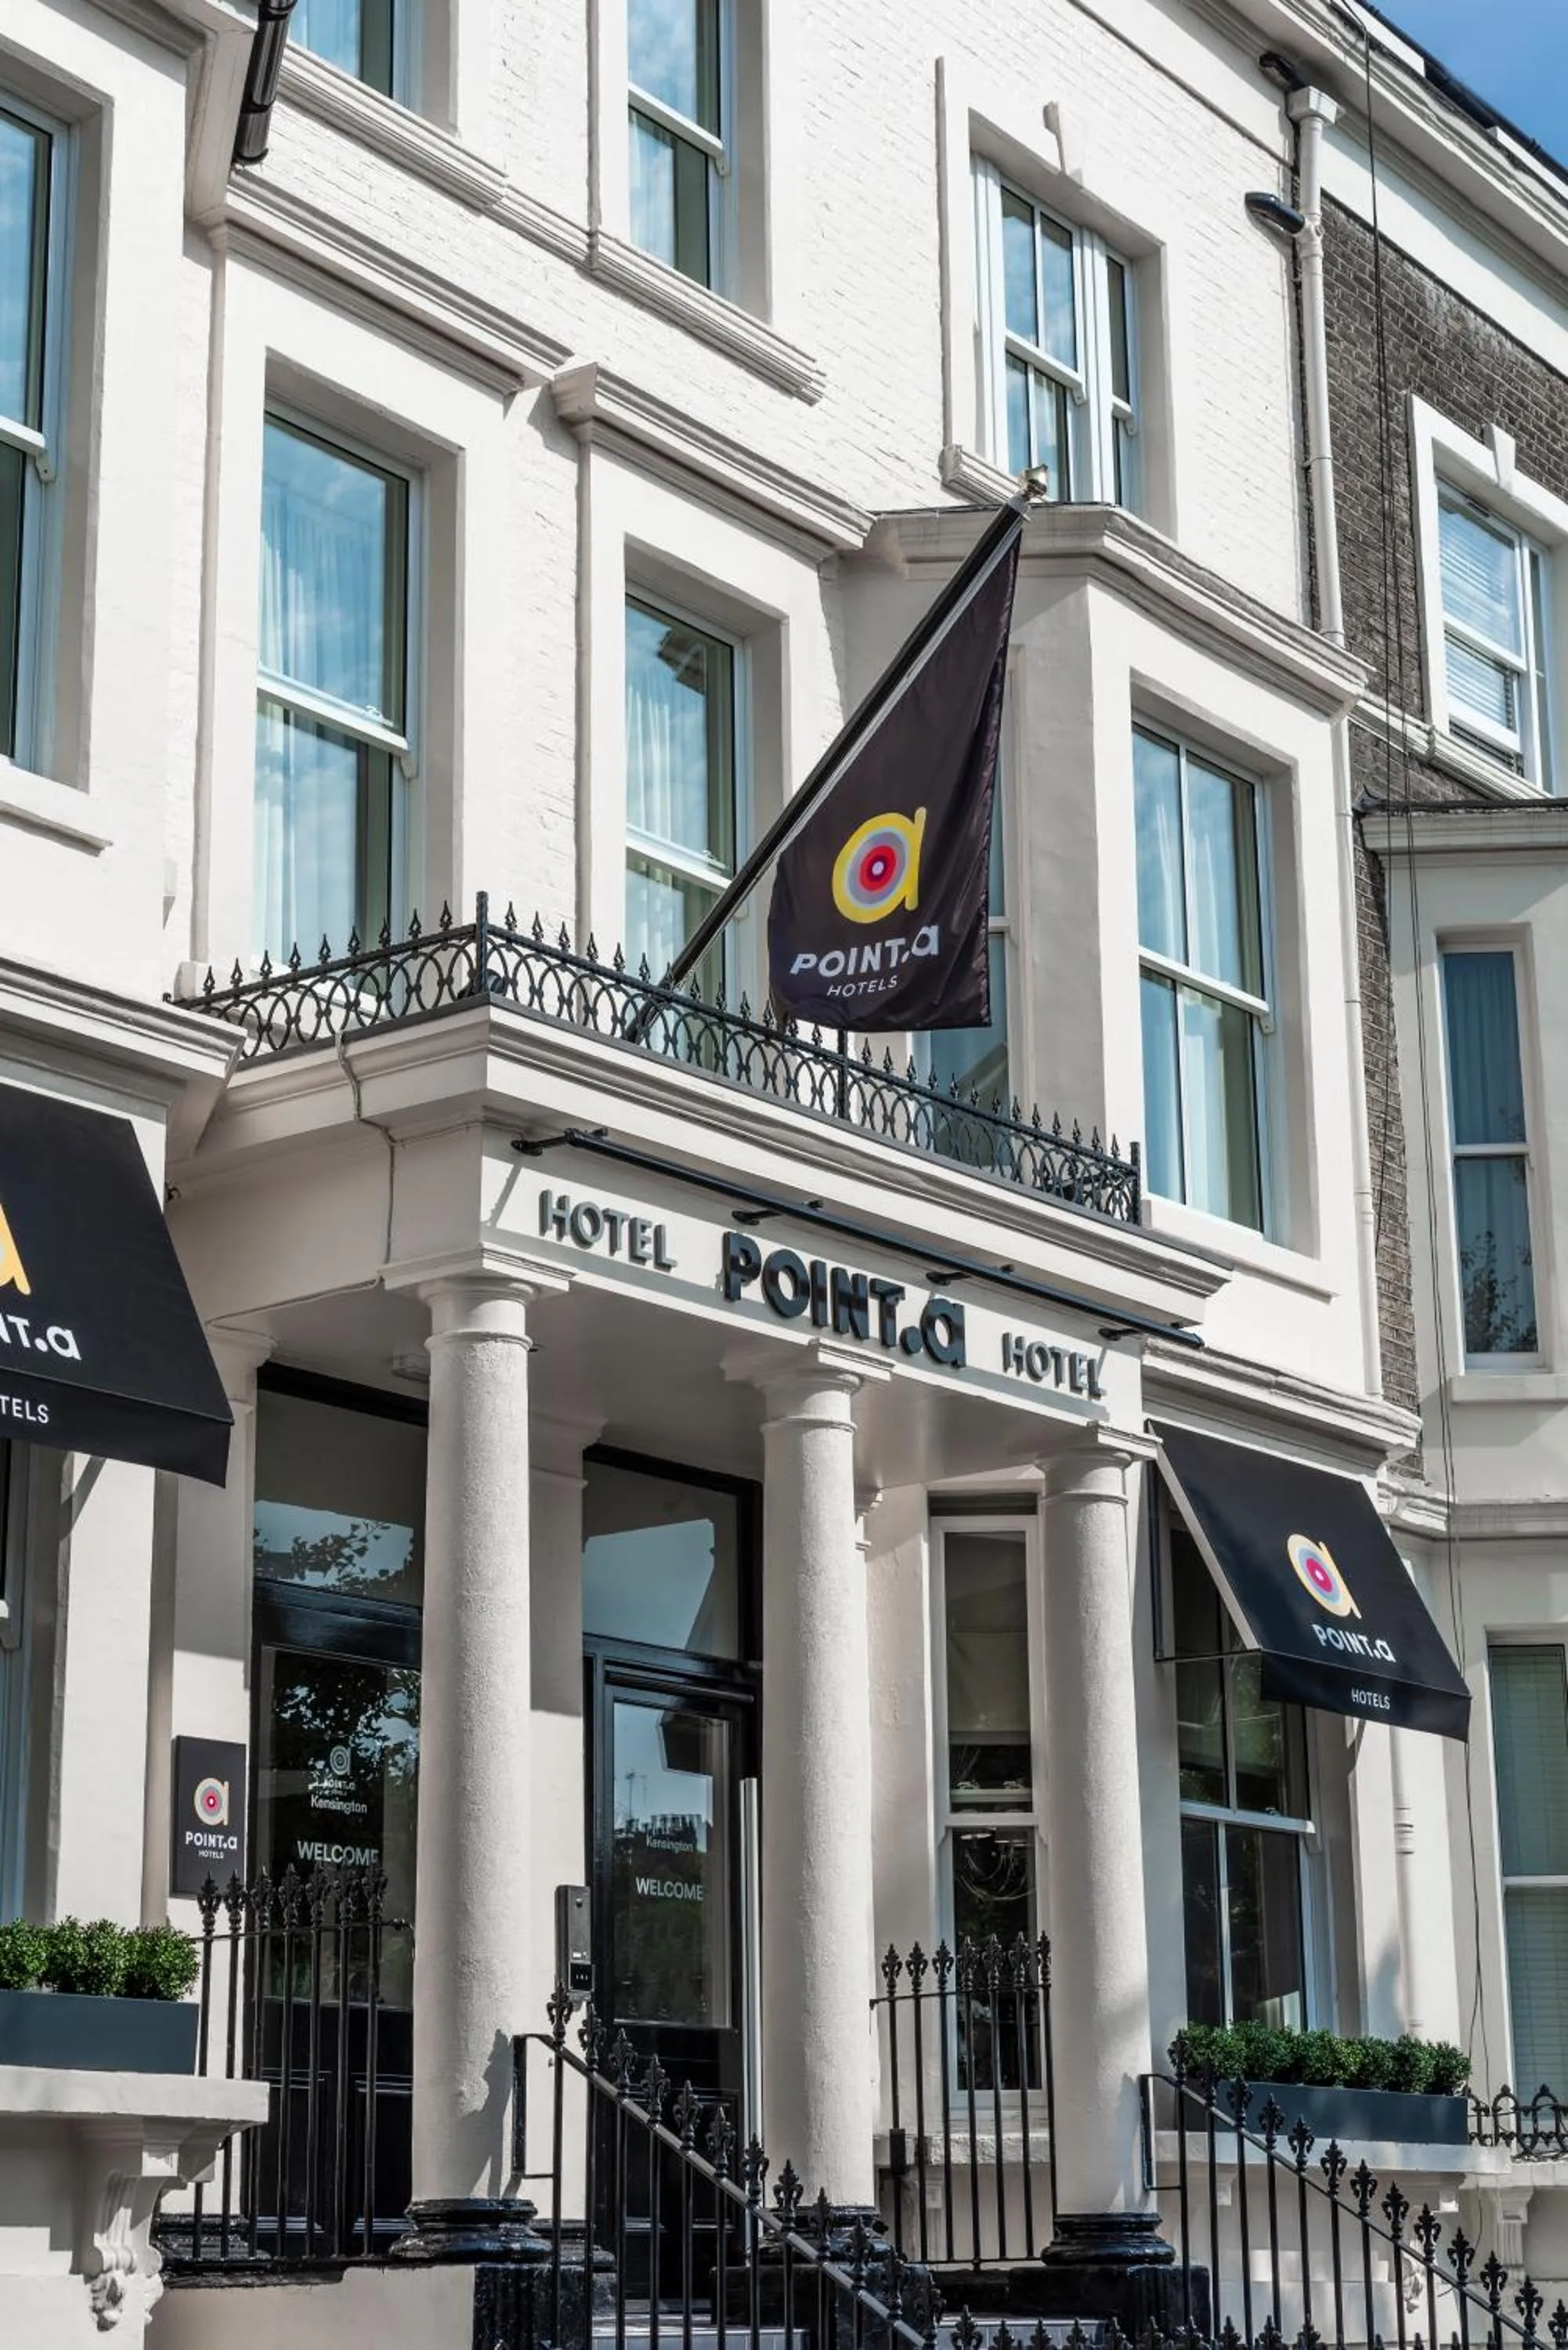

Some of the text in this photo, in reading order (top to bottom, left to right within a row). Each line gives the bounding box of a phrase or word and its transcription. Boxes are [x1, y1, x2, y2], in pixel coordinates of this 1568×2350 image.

[827, 975, 898, 997] HOTELS
[539, 1189, 1107, 1401] HOTEL POINT.a HOTEL
[1311, 1623, 1396, 1663] POINT.a
[1351, 1688, 1390, 1710] HOTELS
[310, 1793, 368, 1815] Kensington
[185, 1831, 237, 1849] POINT.a
[646, 1833, 694, 1854] Kensington
[197, 1849, 224, 1860] HOTELS
[297, 1840, 381, 1867] WELCOME
[635, 1877, 704, 1901] WELCOME
